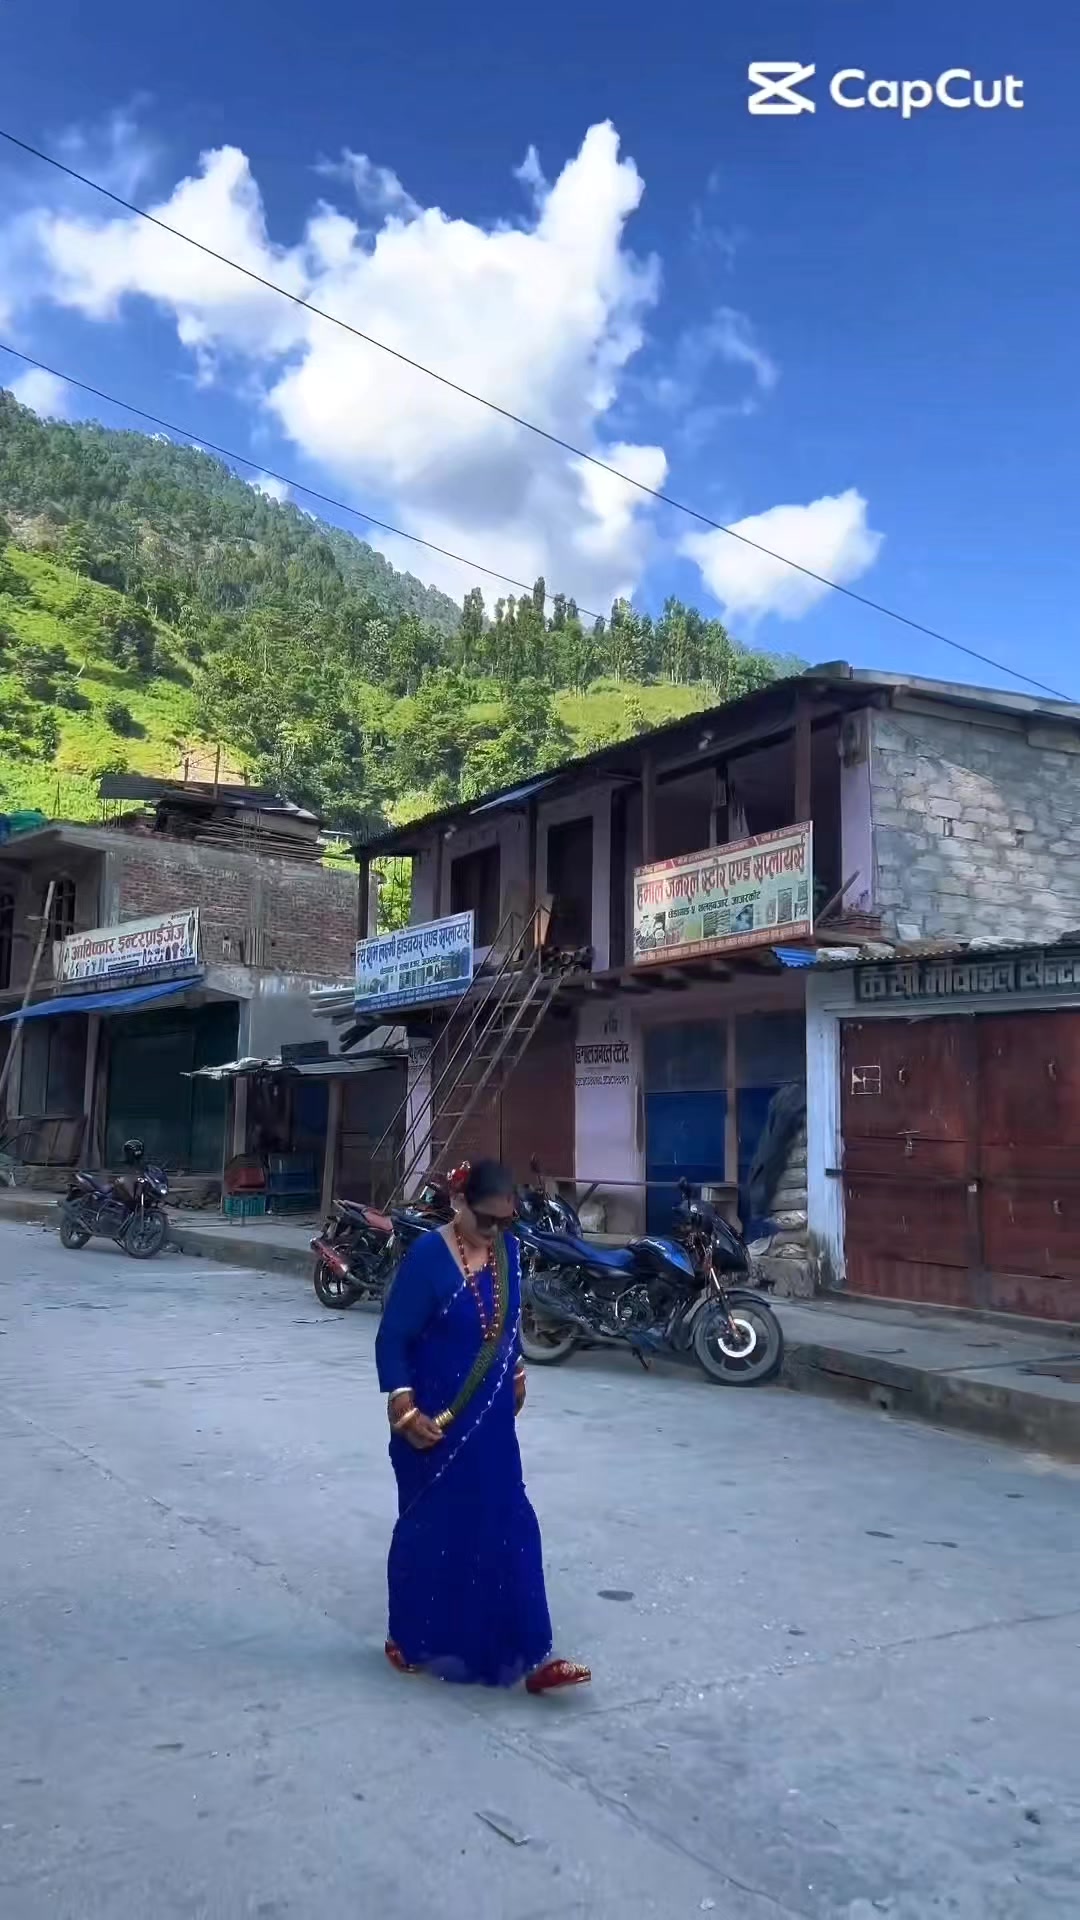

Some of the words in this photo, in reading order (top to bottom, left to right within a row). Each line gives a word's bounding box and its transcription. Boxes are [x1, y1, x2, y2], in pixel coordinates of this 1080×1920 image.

[636, 880, 664, 911] हमाल
[729, 856, 752, 886] एण्ड
[71, 937, 117, 961] आविष्कार
